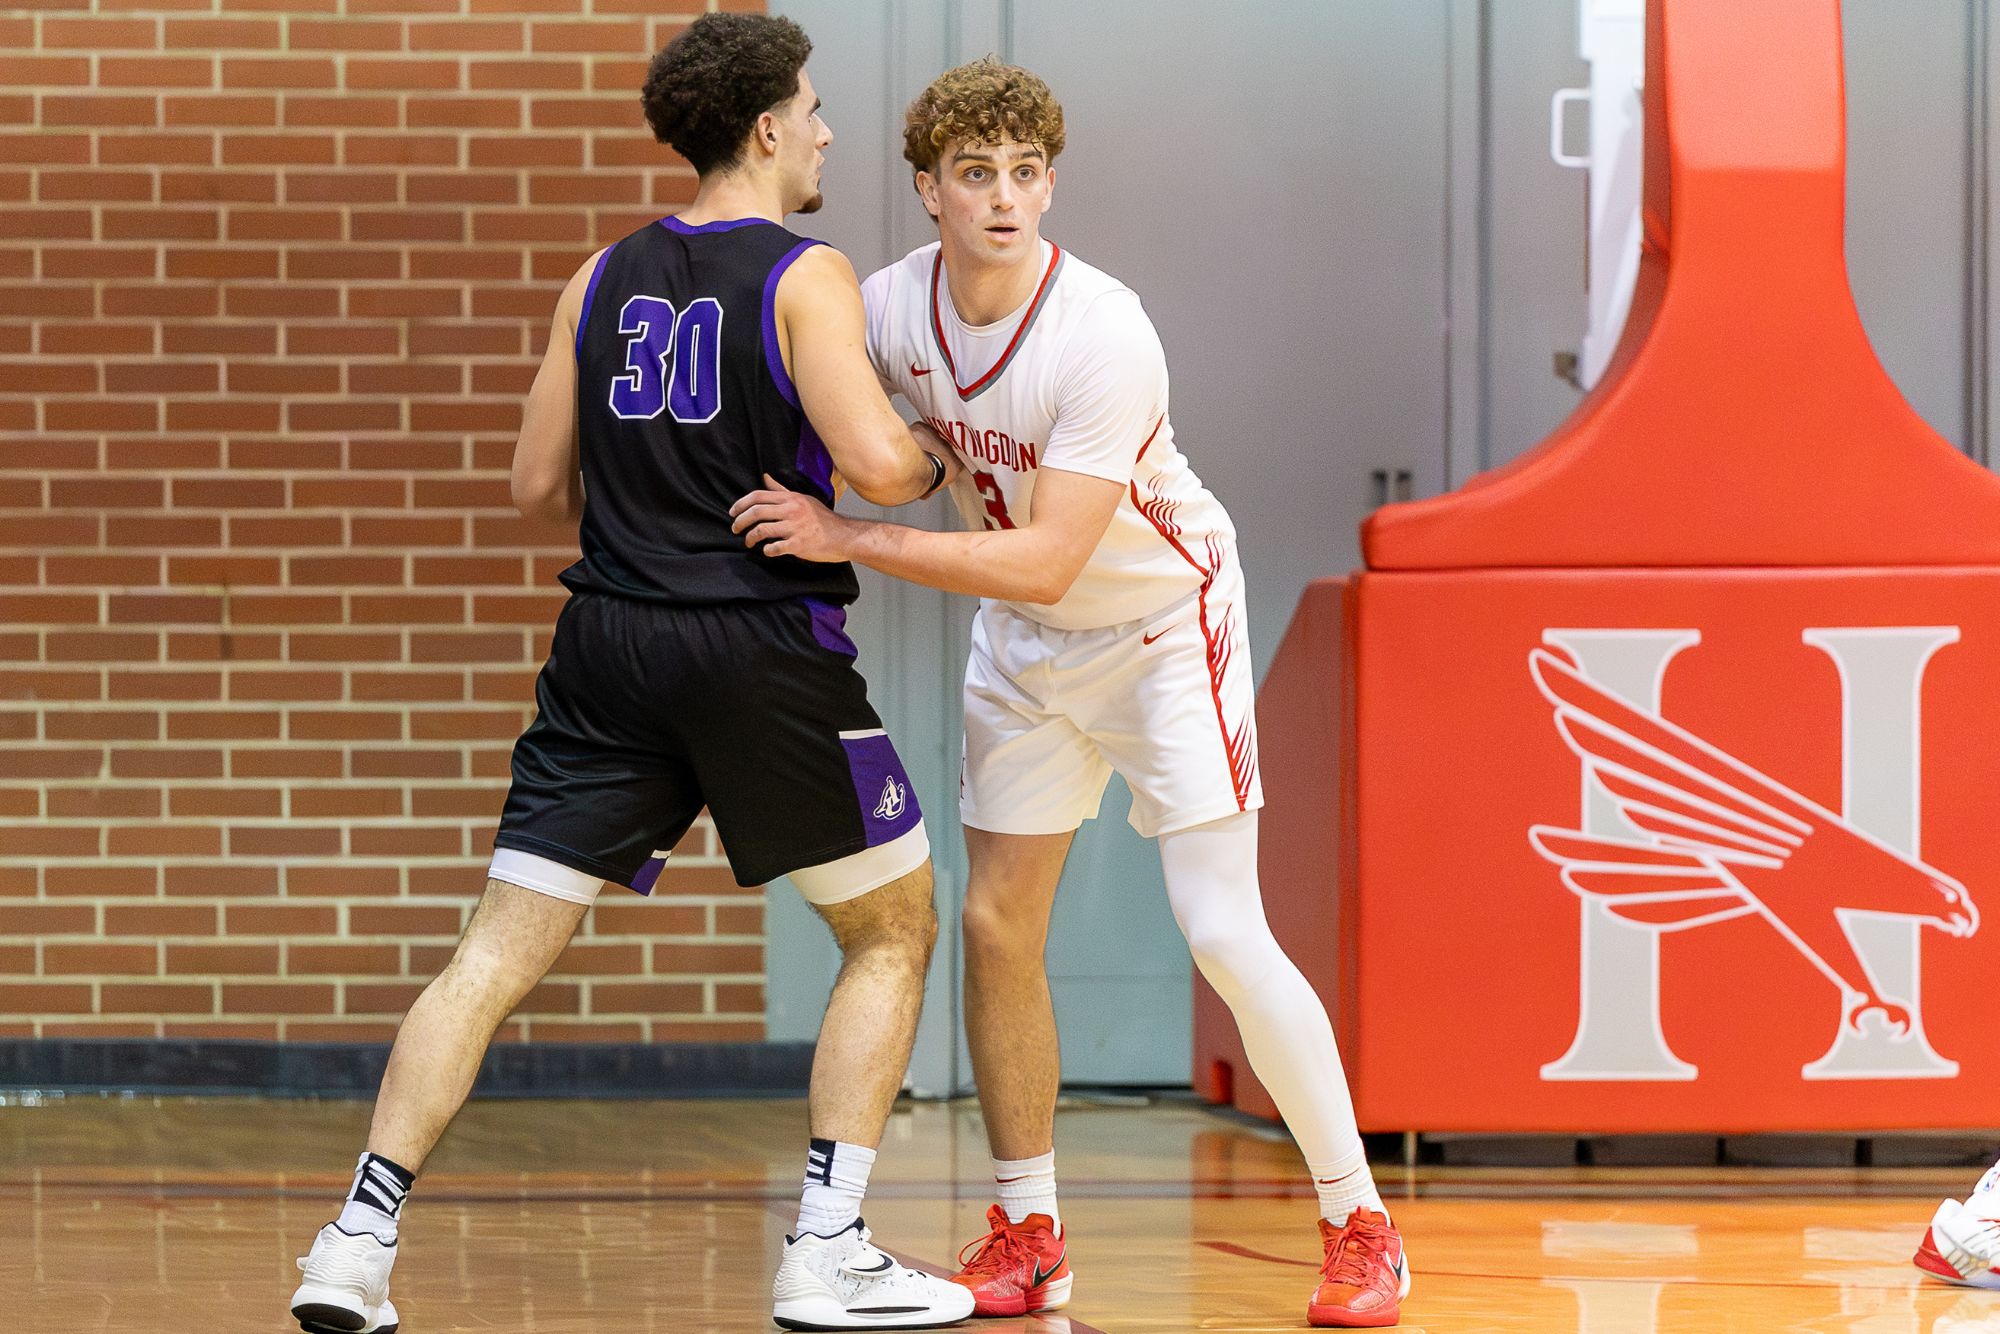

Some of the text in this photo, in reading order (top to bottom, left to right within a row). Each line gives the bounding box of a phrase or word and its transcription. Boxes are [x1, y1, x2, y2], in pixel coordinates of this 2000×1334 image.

[608, 294, 724, 424] 30
[926, 416, 1038, 473] UNTNGDON
[972, 469, 1018, 531] 3
